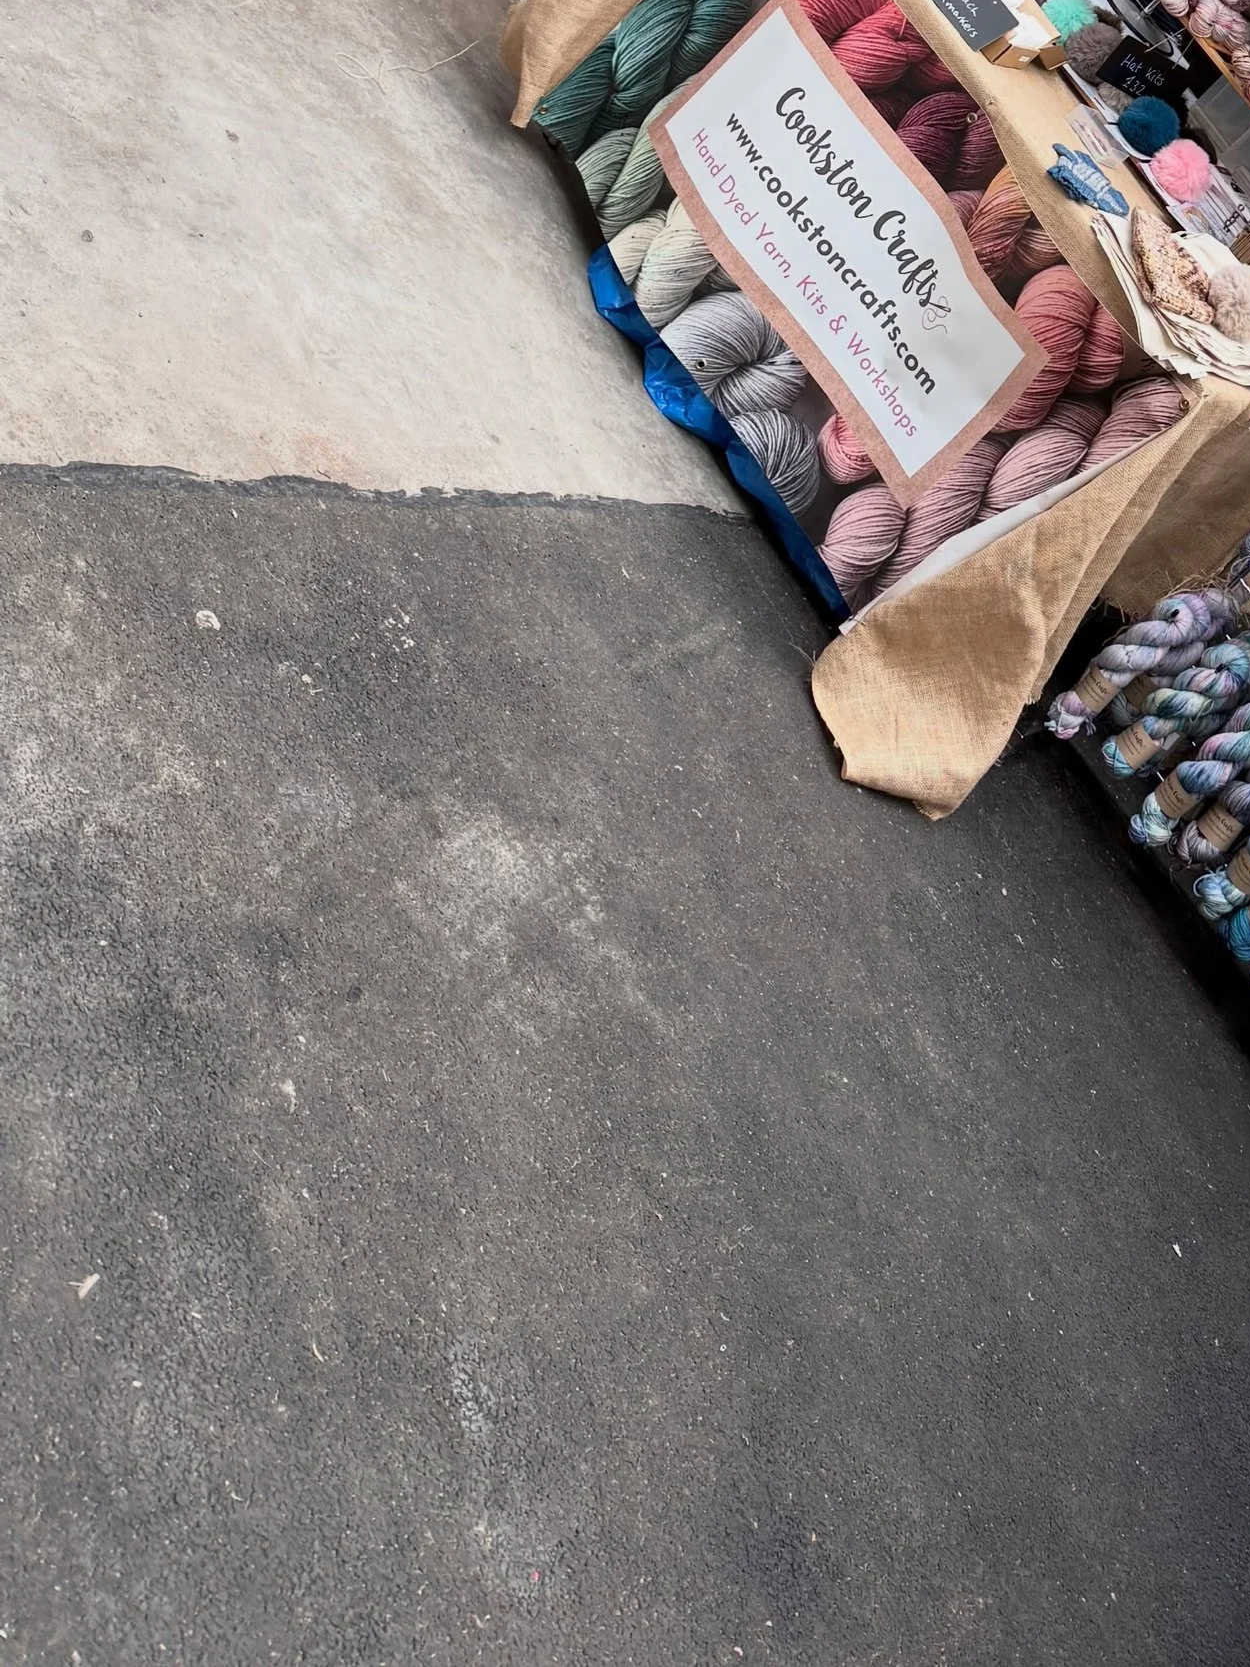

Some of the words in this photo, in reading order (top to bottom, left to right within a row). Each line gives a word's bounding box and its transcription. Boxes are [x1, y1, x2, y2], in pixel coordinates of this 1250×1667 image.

[1120, 53, 1142, 72] Hat
[1145, 69, 1165, 86] Kits
[1123, 75, 1146, 96] £32
[692, 128, 723, 178] Hand
[718, 175, 760, 225] Dyed
[754, 222, 792, 279] Yarn,
[796, 274, 828, 316] Kits
[829, 315, 848, 335] &
[847, 331, 918, 439] Workshops
[725, 112, 937, 395] www.cookstoncrafts.com
[776, 87, 874, 222] Cookston
[873, 209, 939, 307] Crafts
